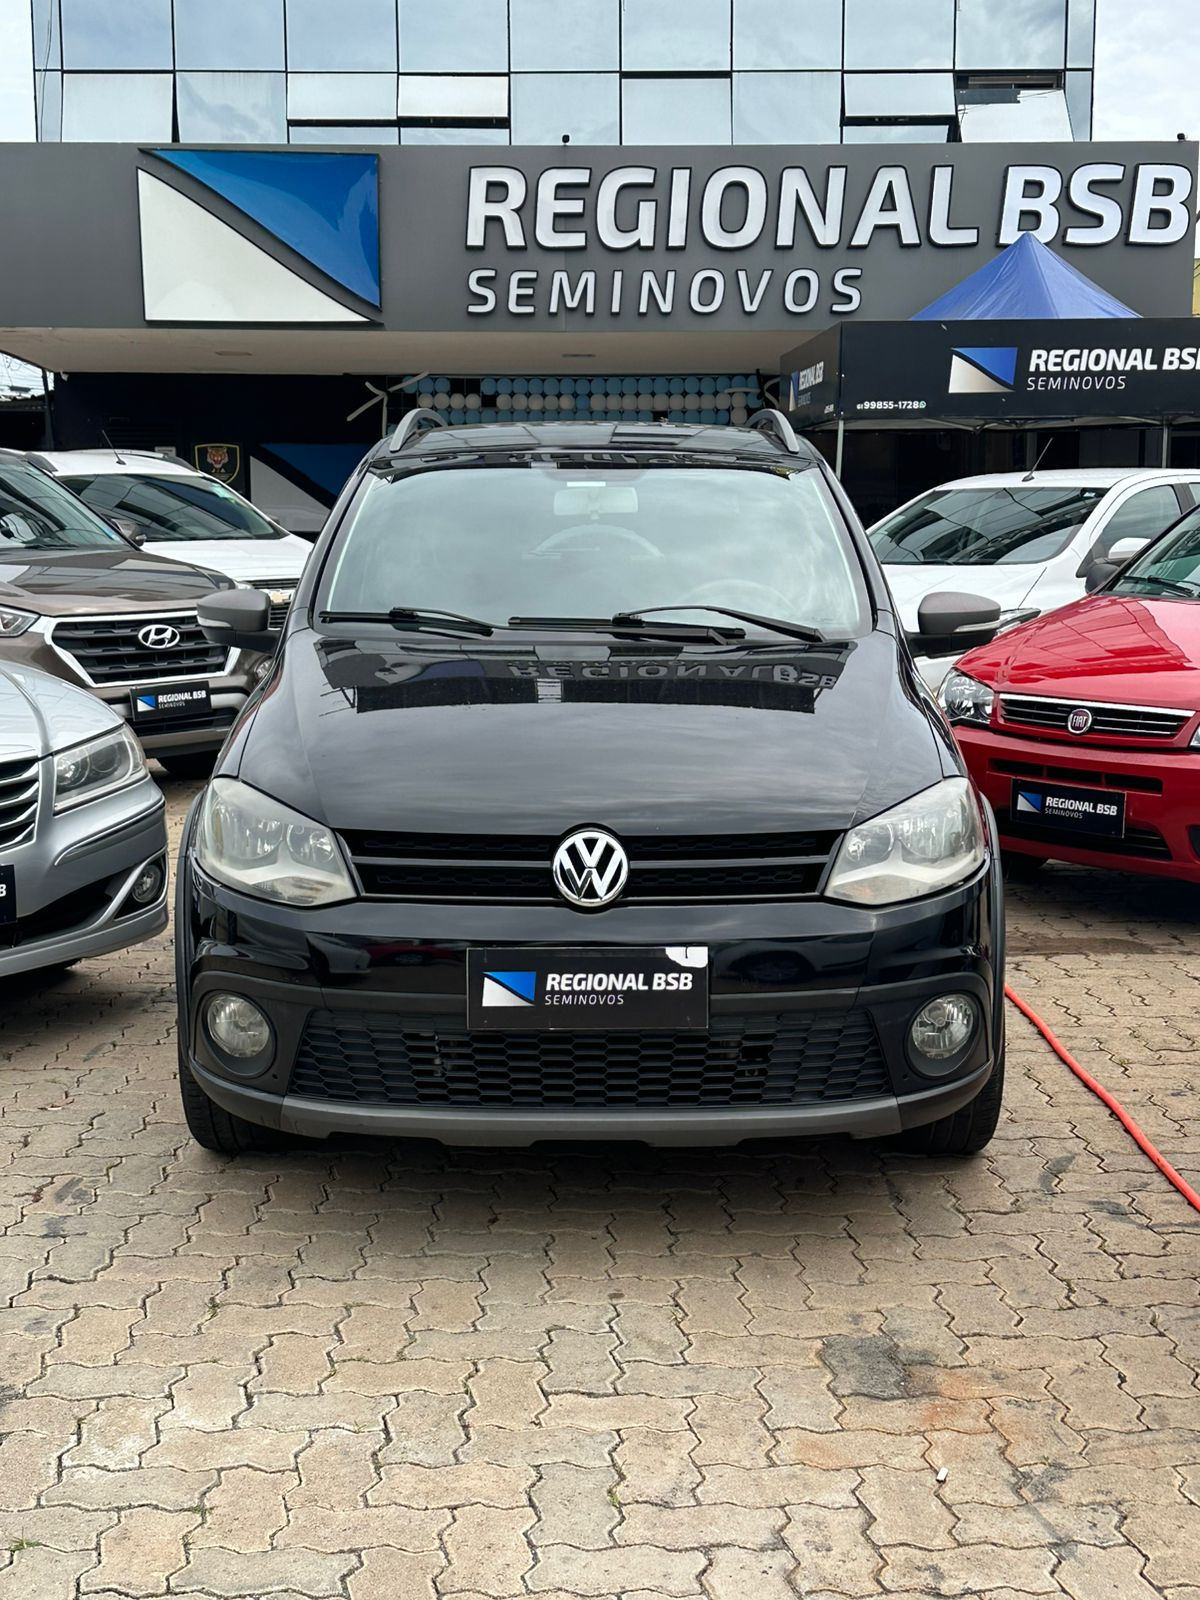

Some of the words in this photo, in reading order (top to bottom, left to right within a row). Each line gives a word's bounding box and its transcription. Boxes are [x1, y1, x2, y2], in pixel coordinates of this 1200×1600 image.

[465, 164, 980, 250] REGIONAL
[997, 162, 1193, 247] BSB
[466, 267, 863, 316] SEMINOVOS
[1028, 348, 1158, 372] REGIONAL
[1162, 347, 1200, 371] BS
[1026, 375, 1127, 391] SEMINOVOS
[158, 691, 193, 703] REGIONAL
[192, 689, 207, 699] BSB
[1045, 796, 1095, 813] REGIONAL
[1096, 803, 1118, 816] BSB
[545, 973, 649, 991] REGIONAL
[652, 972, 693, 991] BSB
[544, 994, 624, 1006] SEMINOVOS
